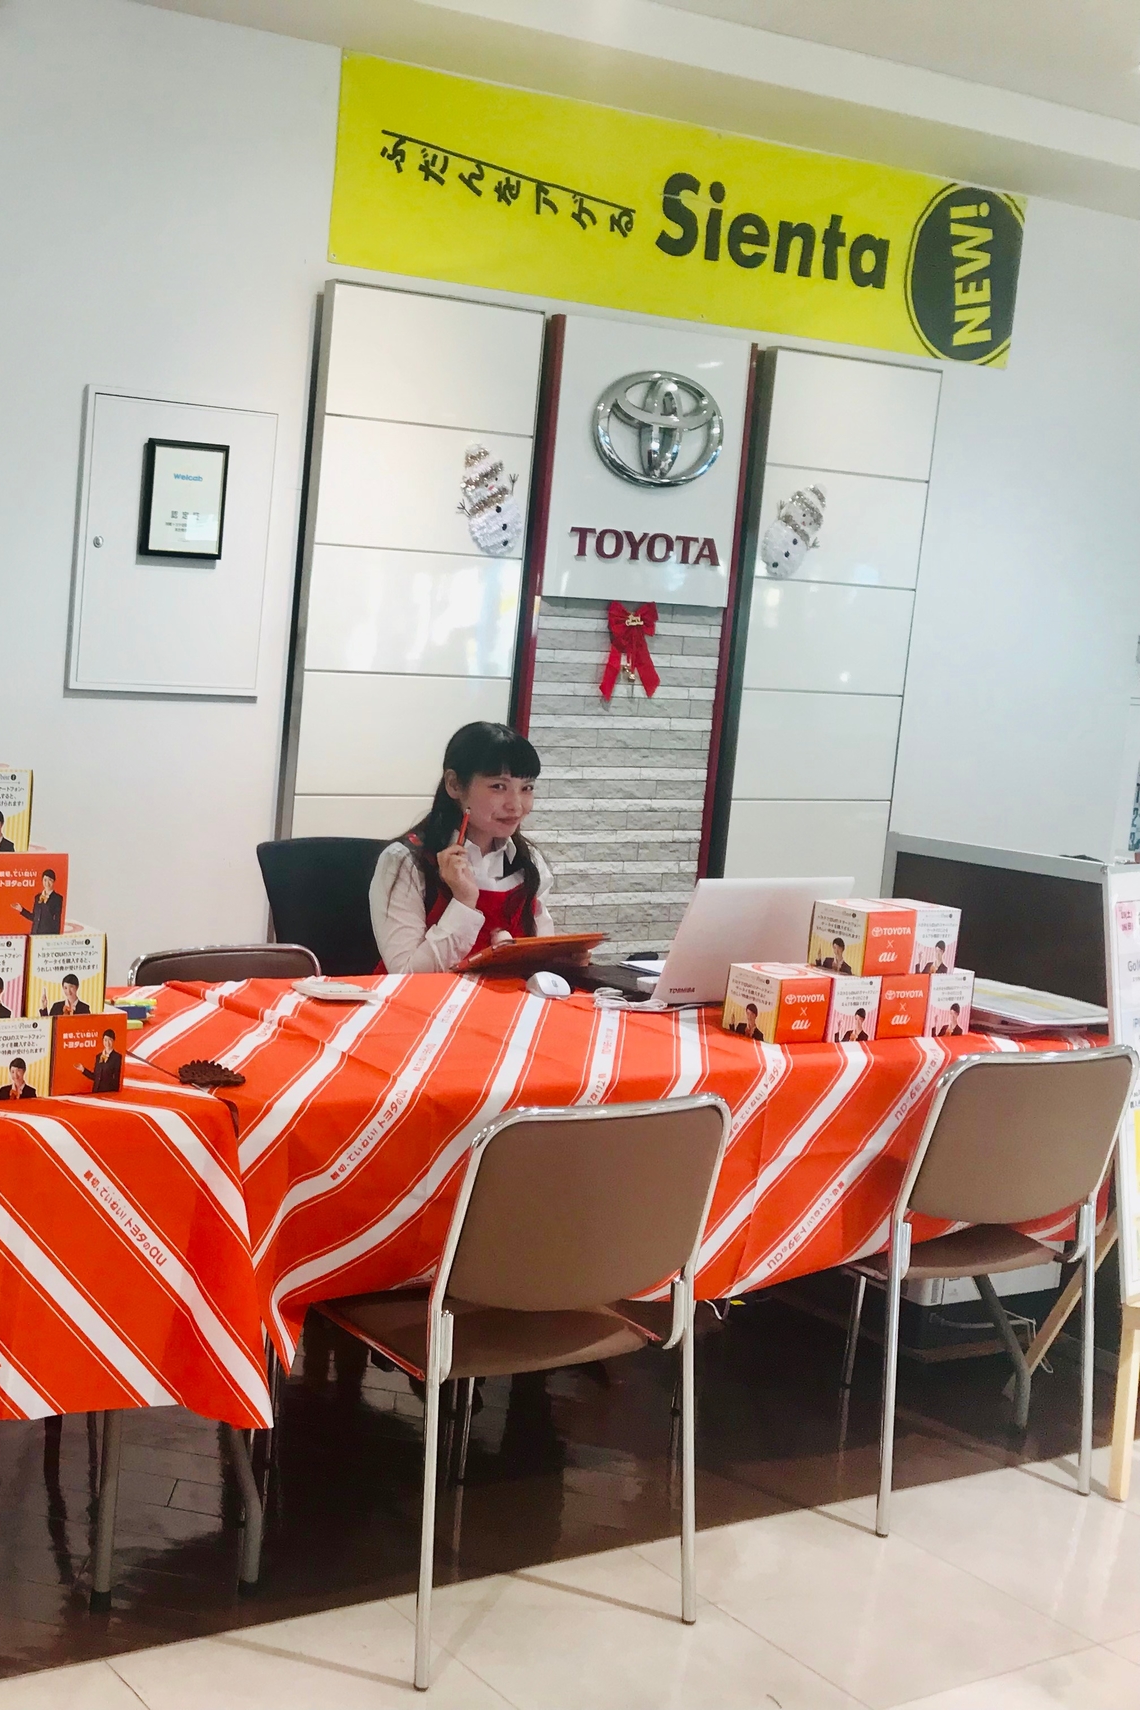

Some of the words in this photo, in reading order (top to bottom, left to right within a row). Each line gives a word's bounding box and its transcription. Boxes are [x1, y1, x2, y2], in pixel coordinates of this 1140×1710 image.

[655, 172, 890, 290] Sienta
[951, 201, 994, 347] NEW!
[570, 527, 720, 566] TOYOTA
[883, 927, 911, 935] TOYOTA
[878, 951, 898, 962] au
[797, 994, 825, 1002] TOYOTA
[895, 990, 923, 998] TOYOTA
[791, 1019, 811, 1030] au
[891, 1014, 910, 1025] au
[124, 1217, 168, 1267] トヨタのau
